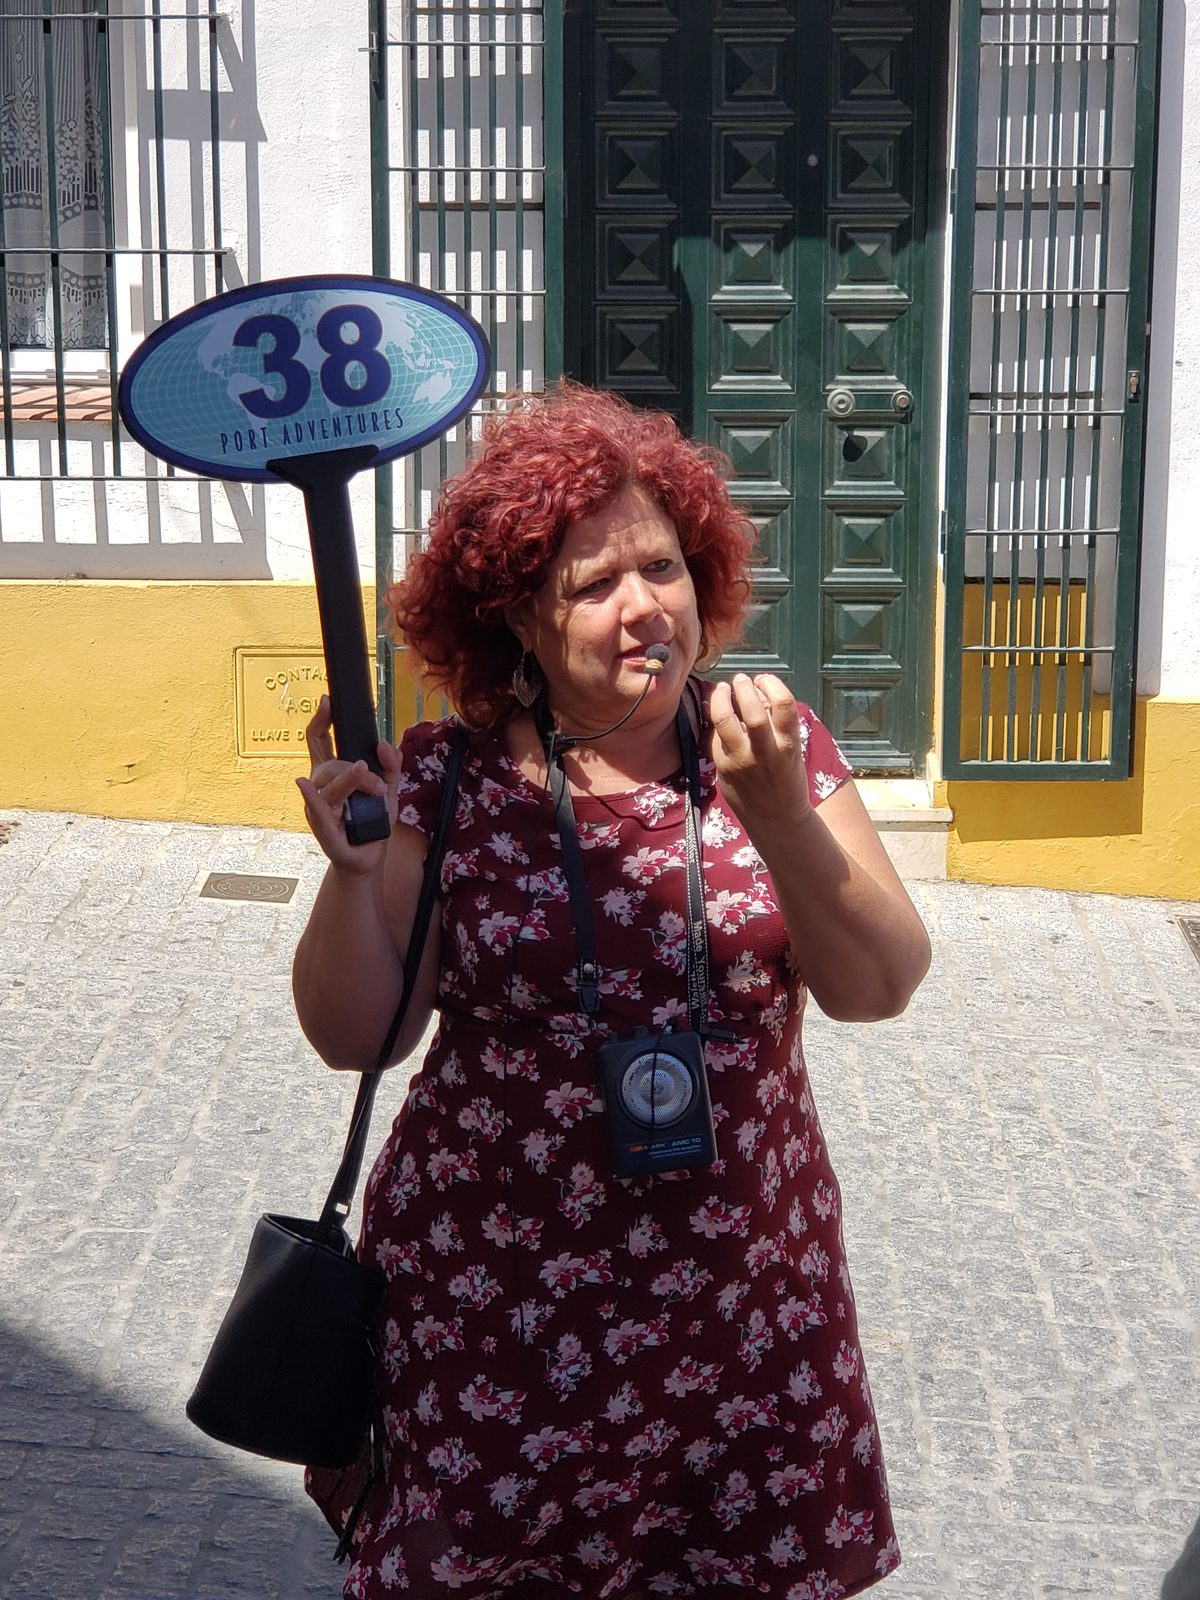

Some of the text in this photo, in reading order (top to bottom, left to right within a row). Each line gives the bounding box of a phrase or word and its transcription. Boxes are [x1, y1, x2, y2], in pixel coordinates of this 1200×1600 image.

[232, 304, 392, 419] 38
[220, 407, 404, 454] PORT ADVENTURES
[265, 666, 327, 691] CONTA
[252, 729, 306, 742] LLAVE D
[693, 920, 703, 953] Made
